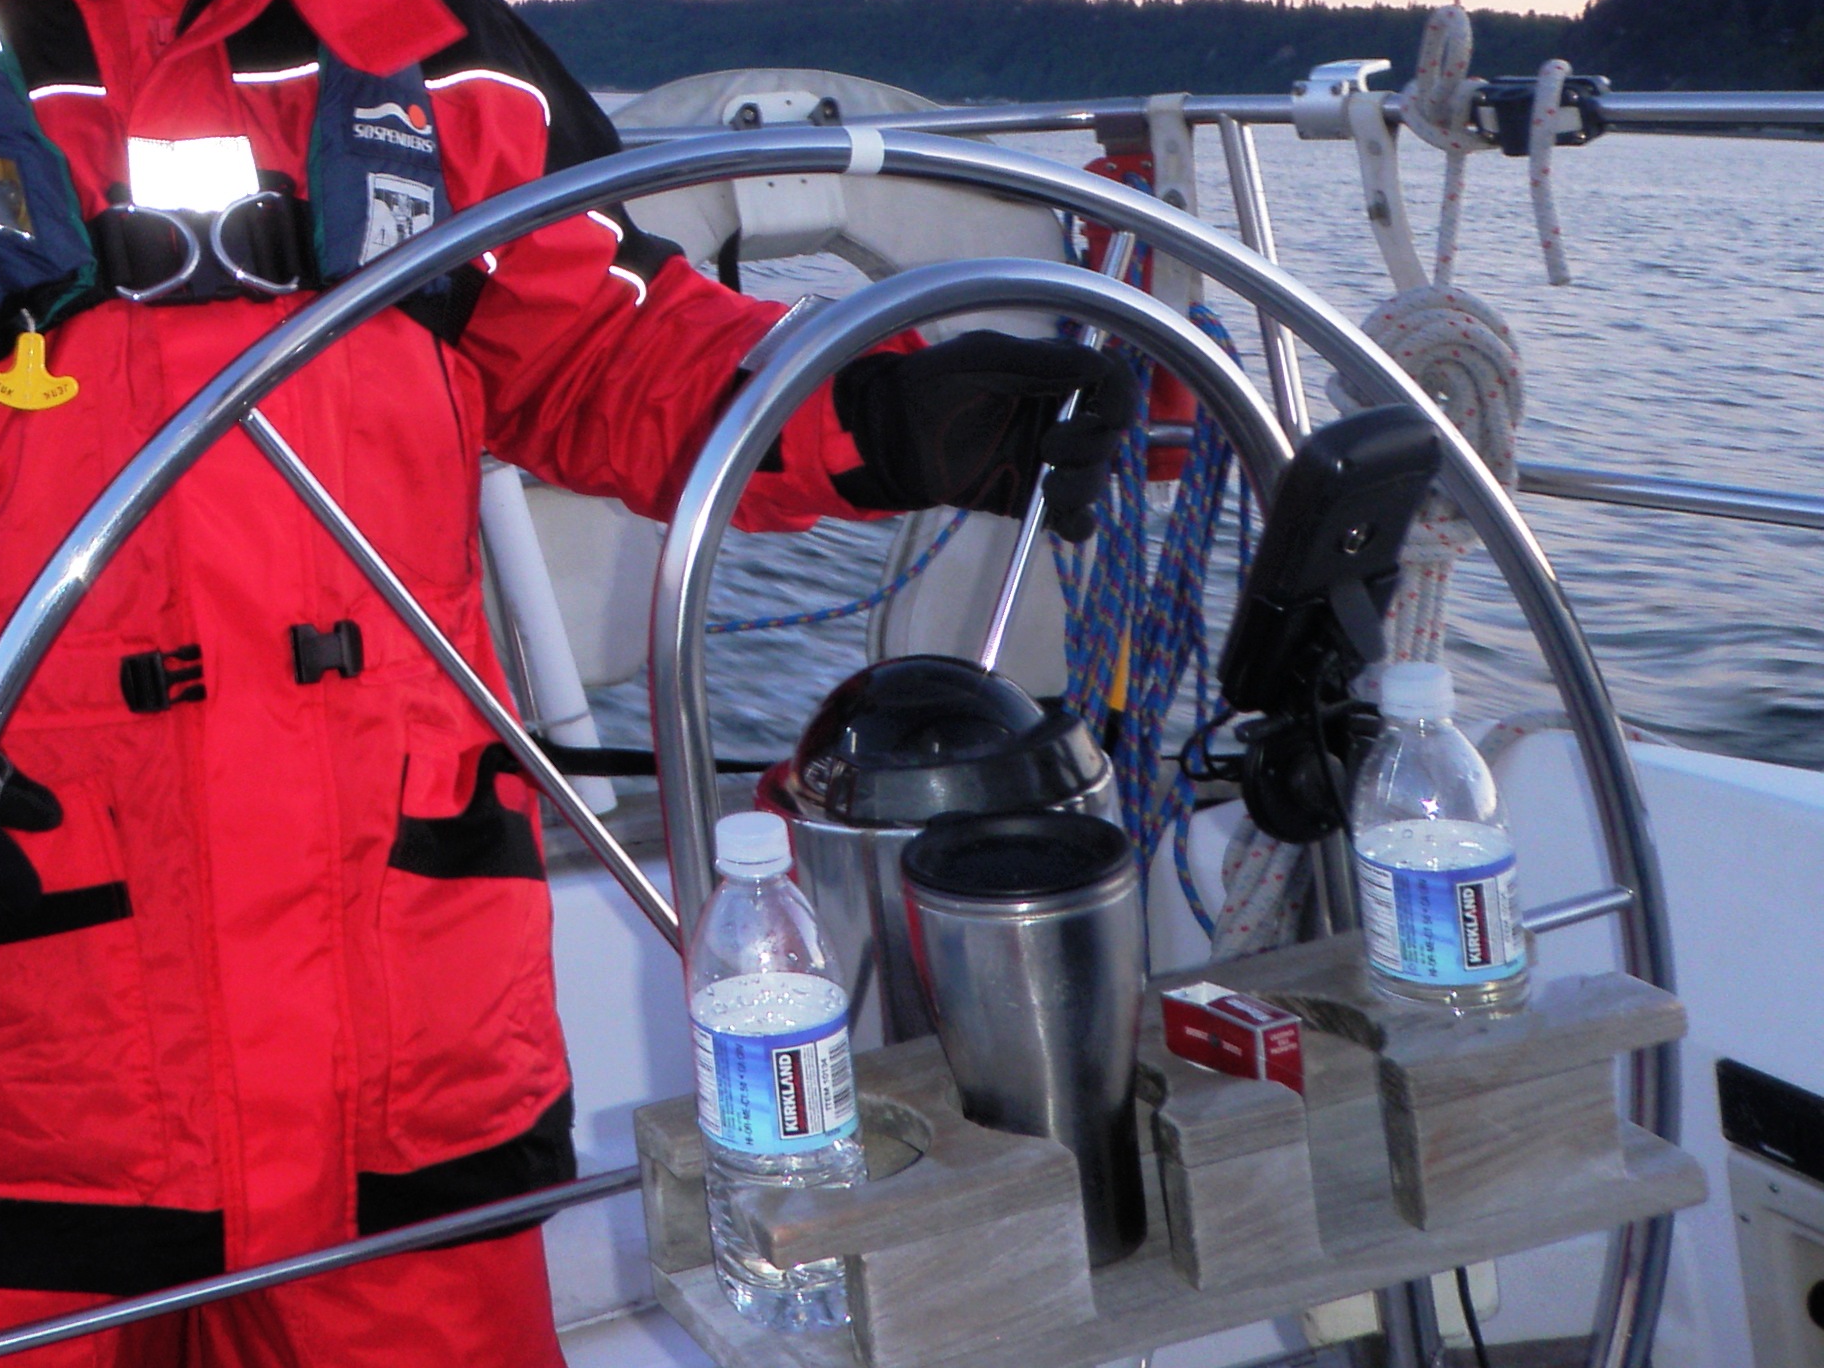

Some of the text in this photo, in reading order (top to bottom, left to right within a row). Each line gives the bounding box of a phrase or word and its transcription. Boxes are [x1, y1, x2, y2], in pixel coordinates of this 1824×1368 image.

[1462, 888, 1482, 963] KIRKLAND
[779, 1054, 799, 1132] KIRKLAND
[823, 1088, 834, 1111] ITEM
